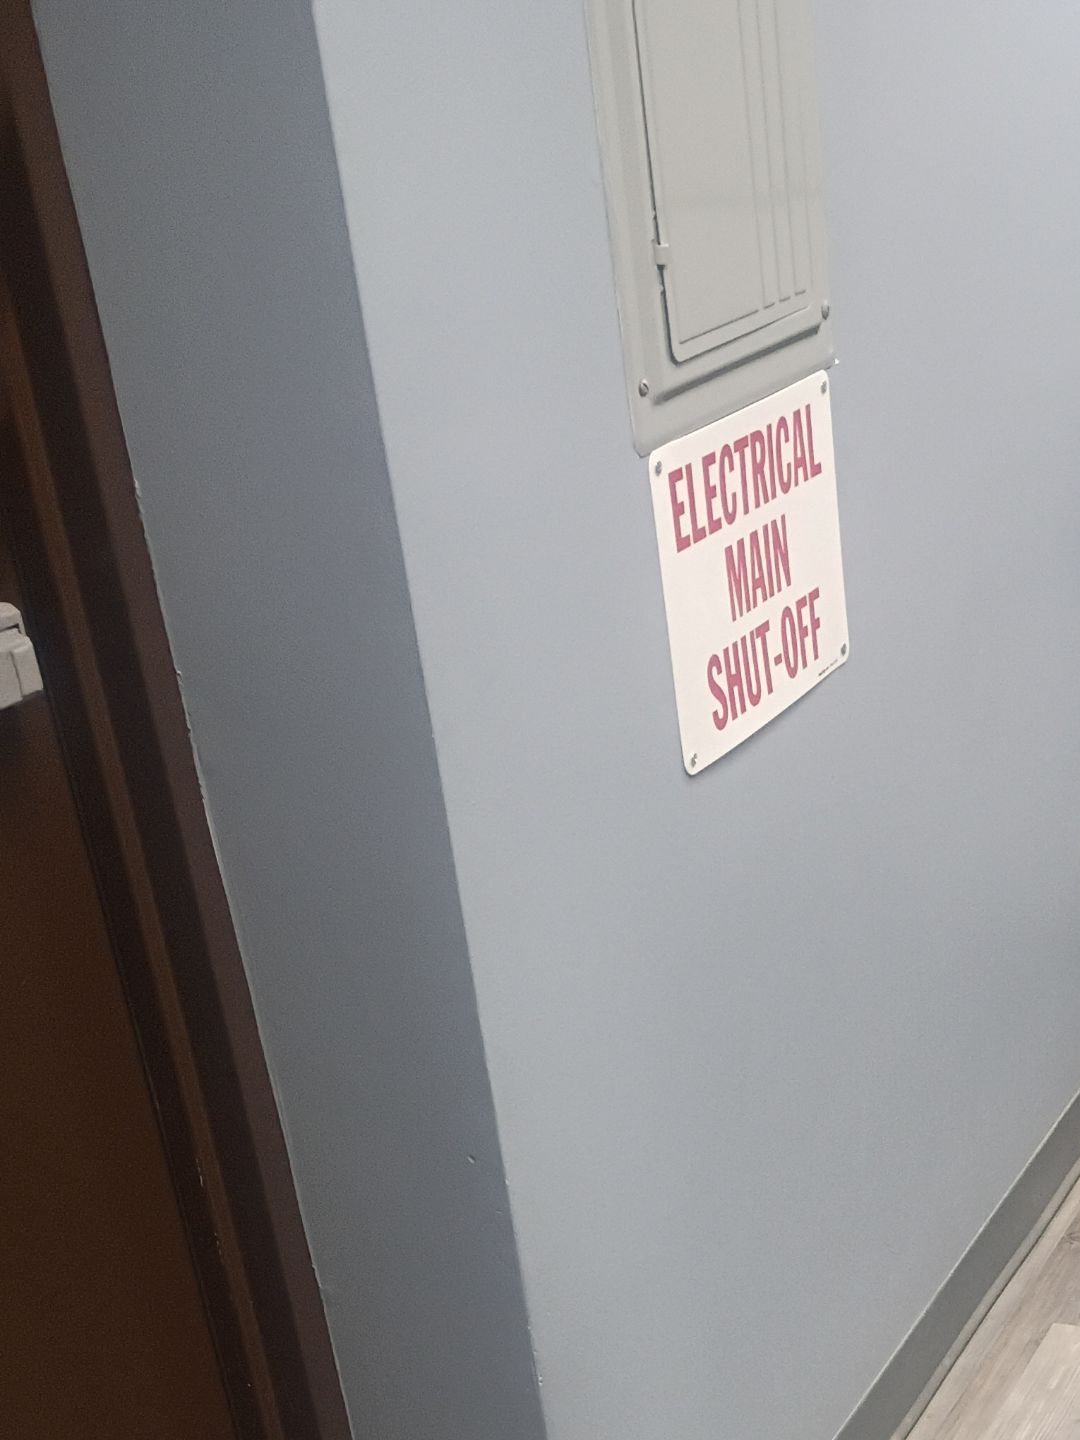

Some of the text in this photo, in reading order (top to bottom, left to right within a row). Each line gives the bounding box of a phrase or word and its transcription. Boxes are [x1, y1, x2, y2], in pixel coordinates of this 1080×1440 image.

[668, 404, 822, 553] ELECTRICAL
[724, 514, 791, 622] MAIN
[707, 587, 821, 731] SHUT-OFF
